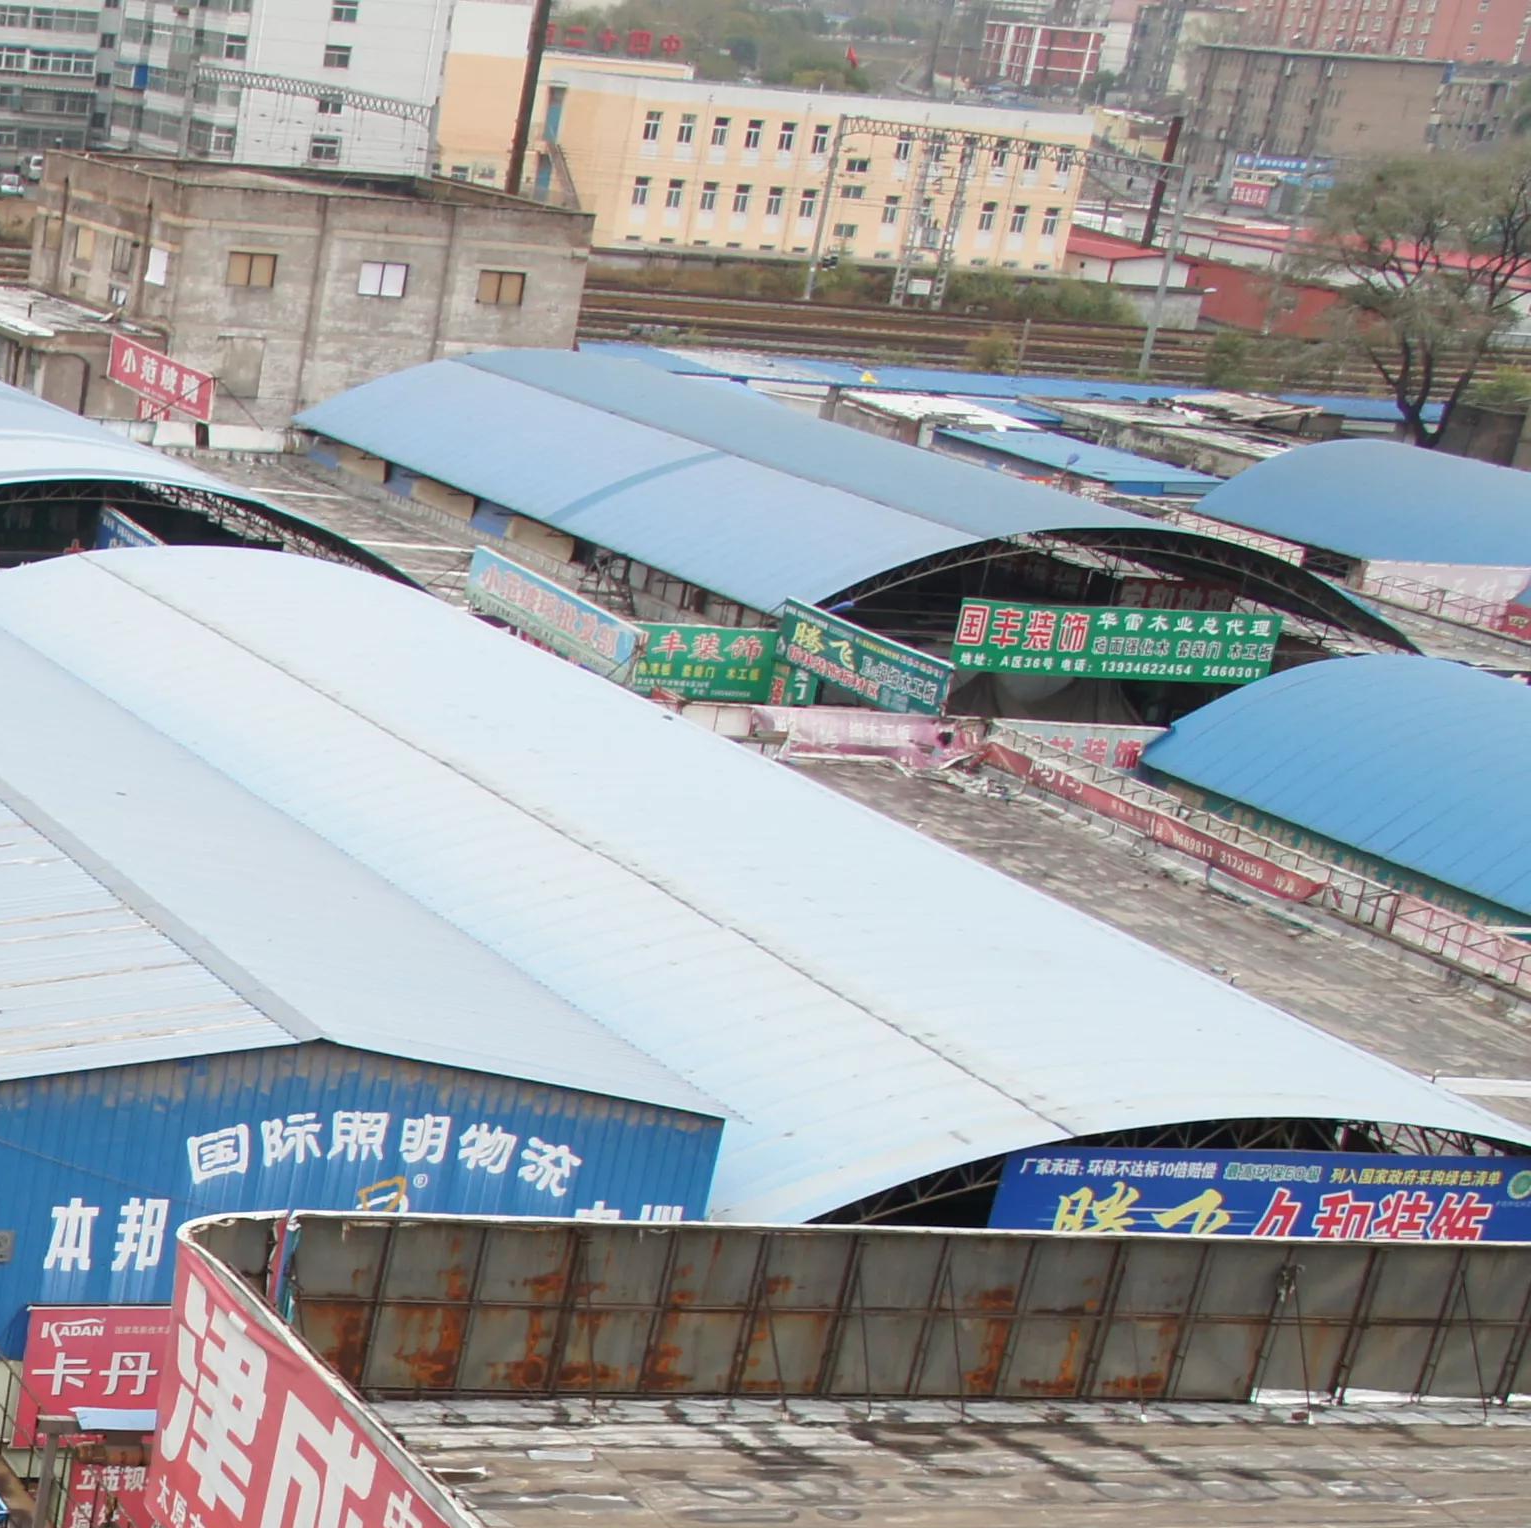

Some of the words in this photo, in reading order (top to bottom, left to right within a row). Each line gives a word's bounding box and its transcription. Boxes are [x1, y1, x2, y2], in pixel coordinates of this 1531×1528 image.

[955, 604, 1090, 652] 国丰装饰
[1097, 611, 1271, 637] 华雷木业总代理
[638, 630, 766, 664] 丰装饰
[1177, 639, 1220, 660] 套装门
[1227, 641, 1274, 662] 木工板
[959, 652, 994, 668] 地址：
[999, 656, 1053, 671] A区36号
[1202, 666, 1261, 679] 2660301
[186, 1110, 583, 1198] 国际照明物流
[43, 1197, 170, 1273] 本邦
[40, 1317, 105, 1347] KADAN
[31, 1350, 158, 1396] 卡丹
